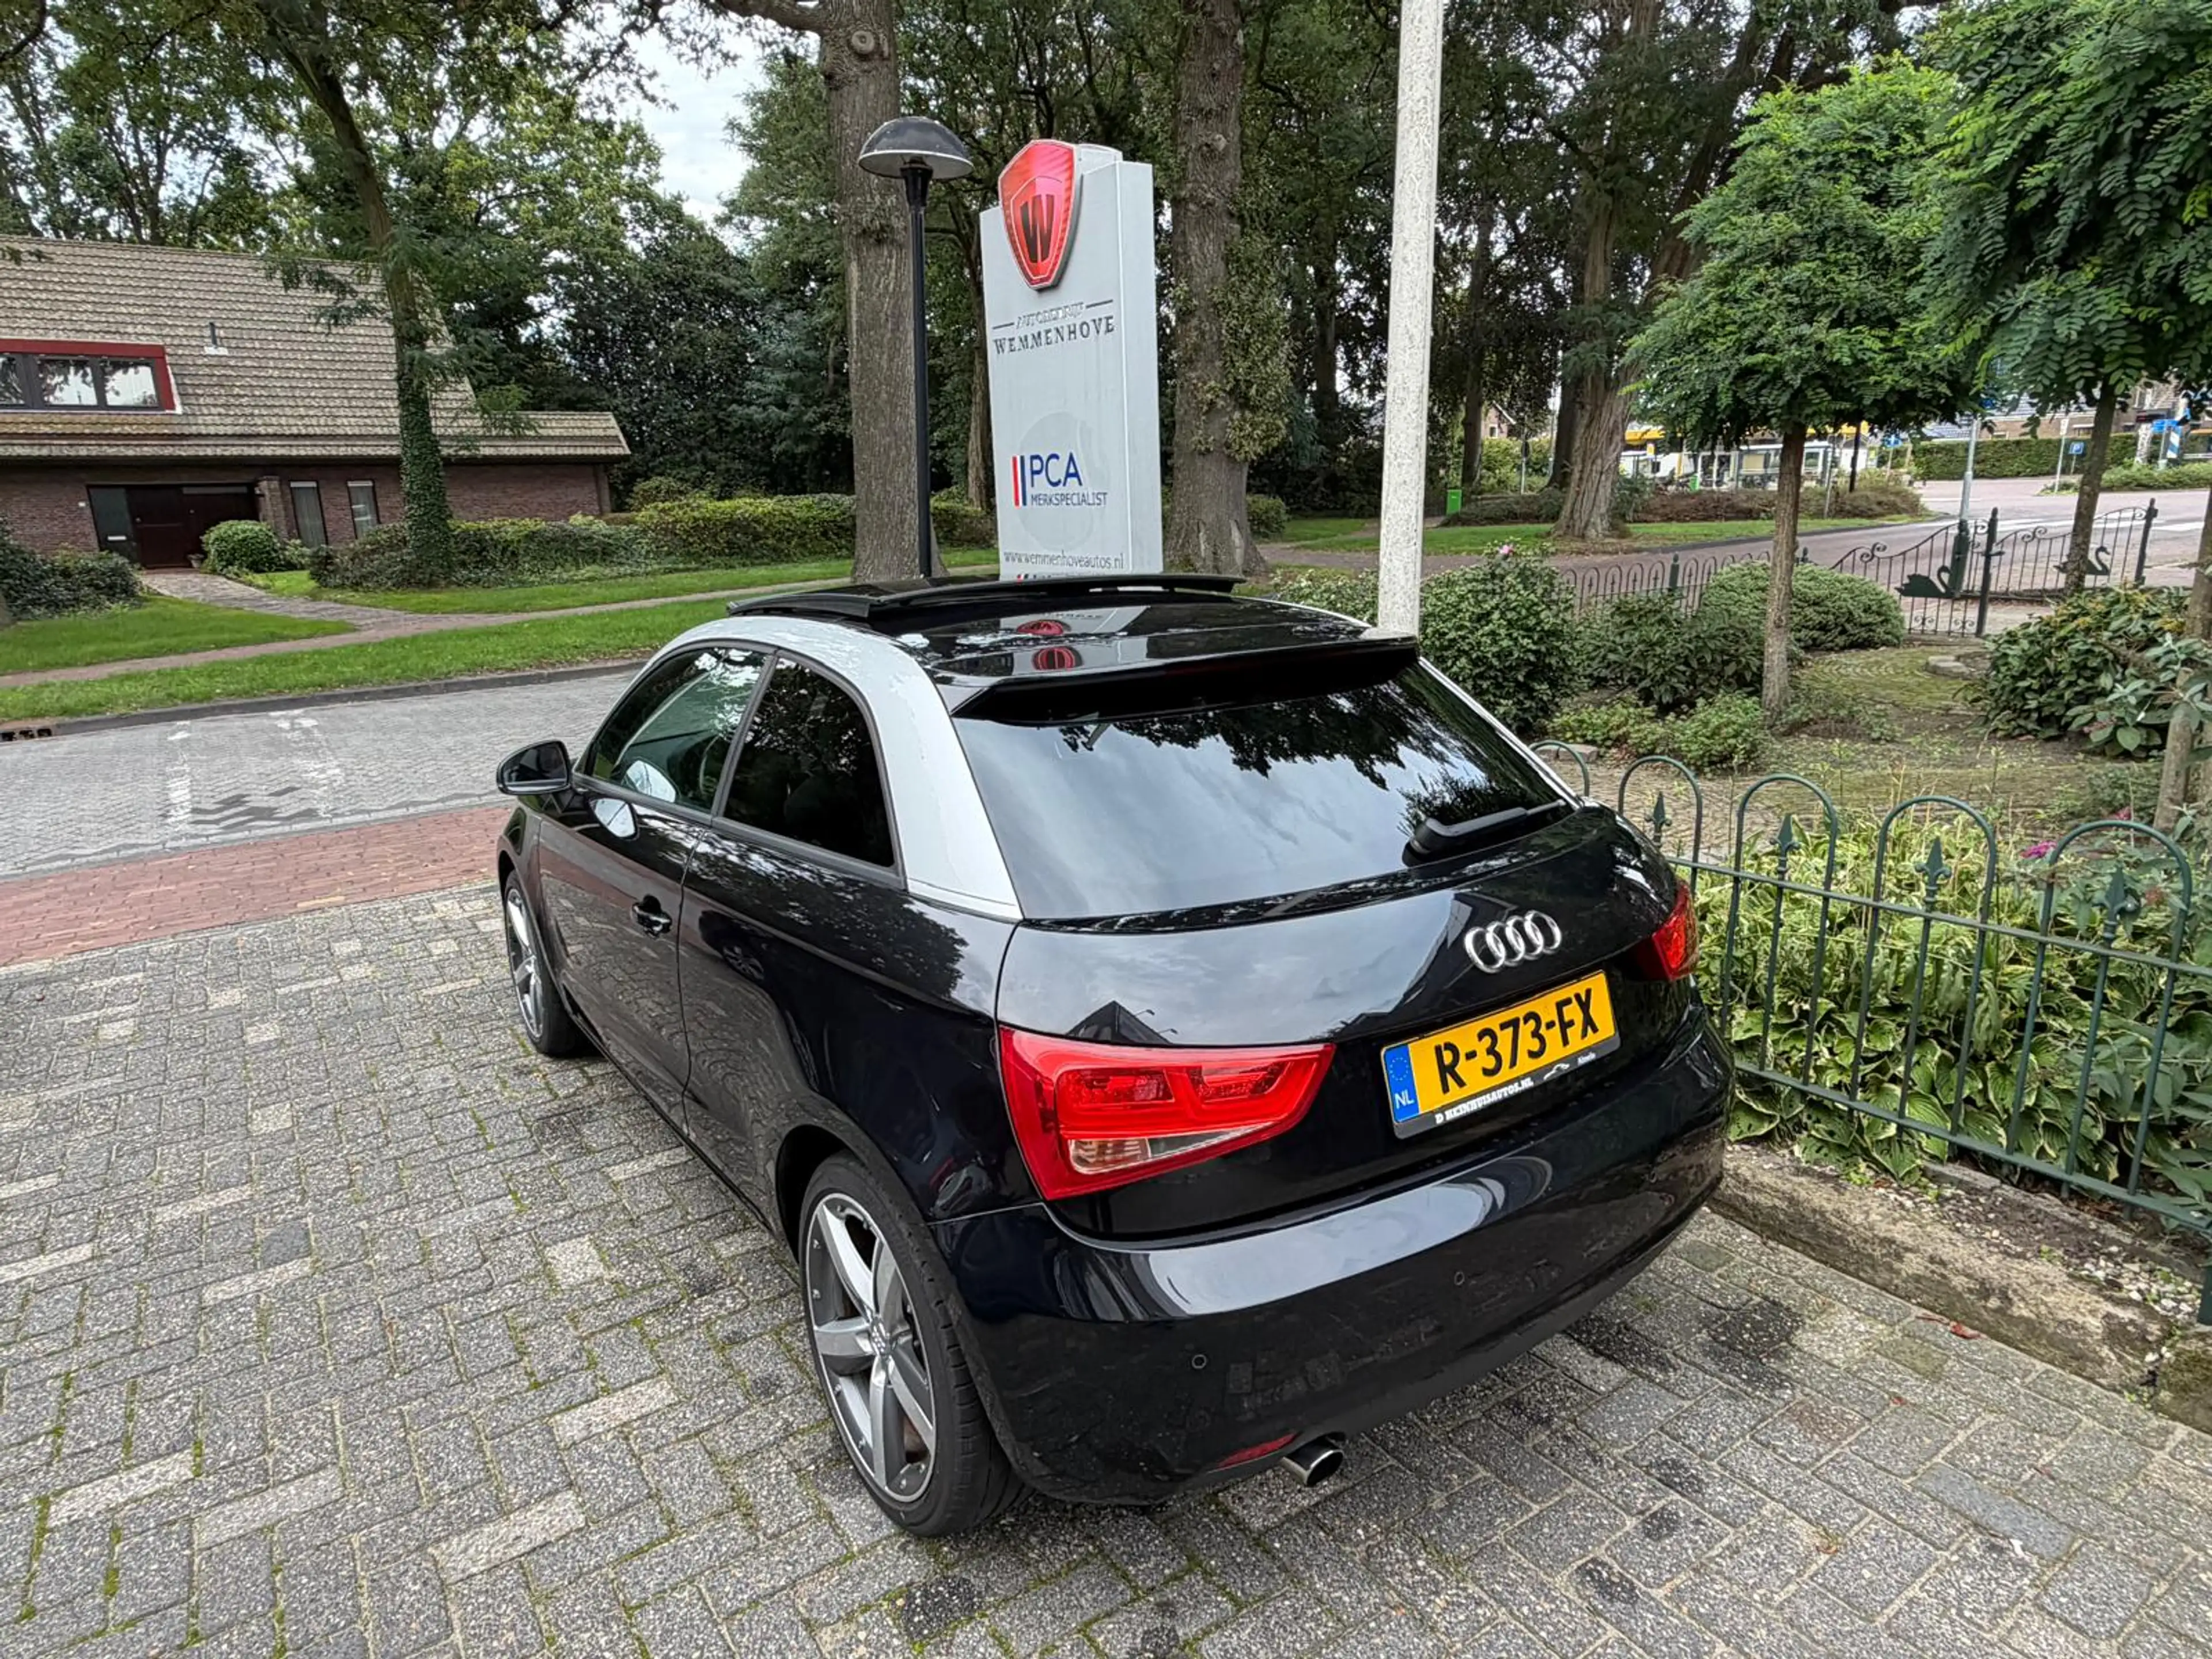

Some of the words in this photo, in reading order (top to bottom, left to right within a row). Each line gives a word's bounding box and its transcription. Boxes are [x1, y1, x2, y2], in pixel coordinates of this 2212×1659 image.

[993, 315, 1115, 355] WEMMENHOVE
[1029, 452, 1083, 488] PCA
[1031, 492, 1108, 507] MERKSPECIALIST
[1434, 987, 1599, 1095] R-373-FX
[1394, 1089, 1415, 1110] NL
